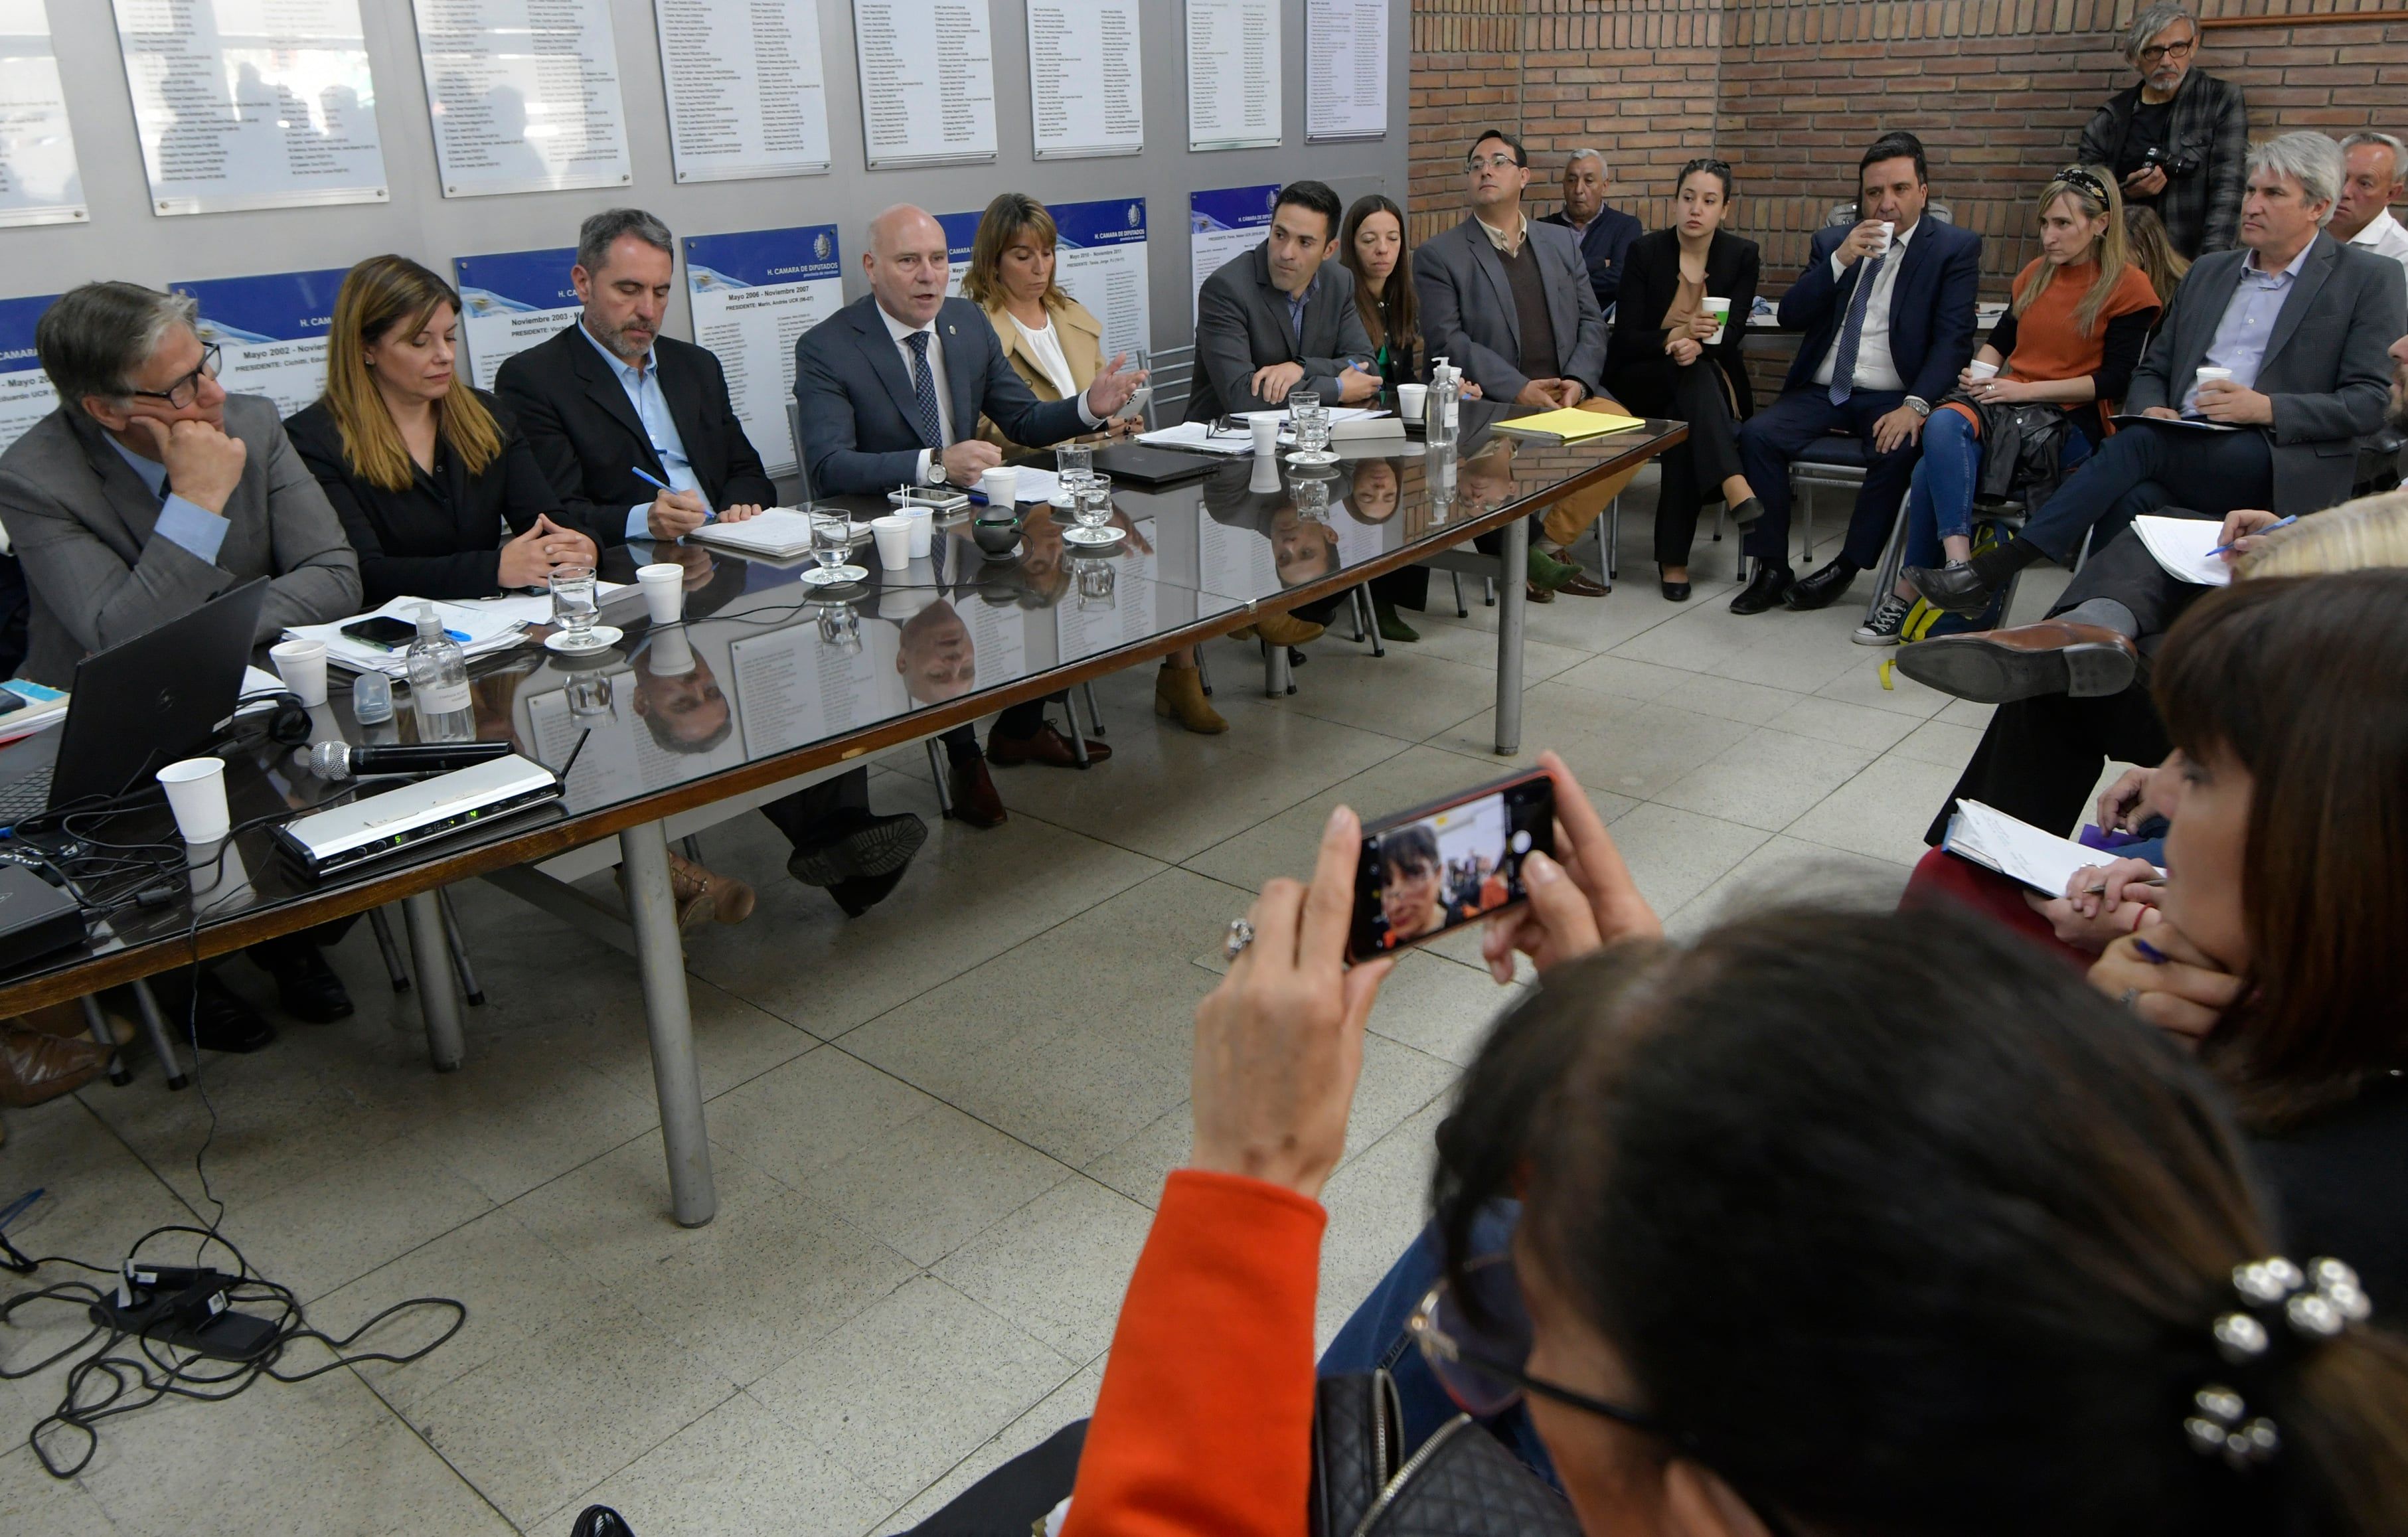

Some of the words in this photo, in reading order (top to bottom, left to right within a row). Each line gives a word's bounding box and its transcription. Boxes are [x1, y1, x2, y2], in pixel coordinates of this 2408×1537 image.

[774, 266, 800, 275] CAMARA
[809, 262, 838, 271] DIPUTADOS
[311, 317, 332, 326] CAM
[511, 316, 550, 326] Noviembre
[552, 313, 568, 321] 2003
[270, 347, 289, 356] 2002
[8, 378, 35, 387] Mayo
[38, 375, 50, 384] 20
[0, 394, 29, 402] duardo
[394, 835, 402, 844] 5
